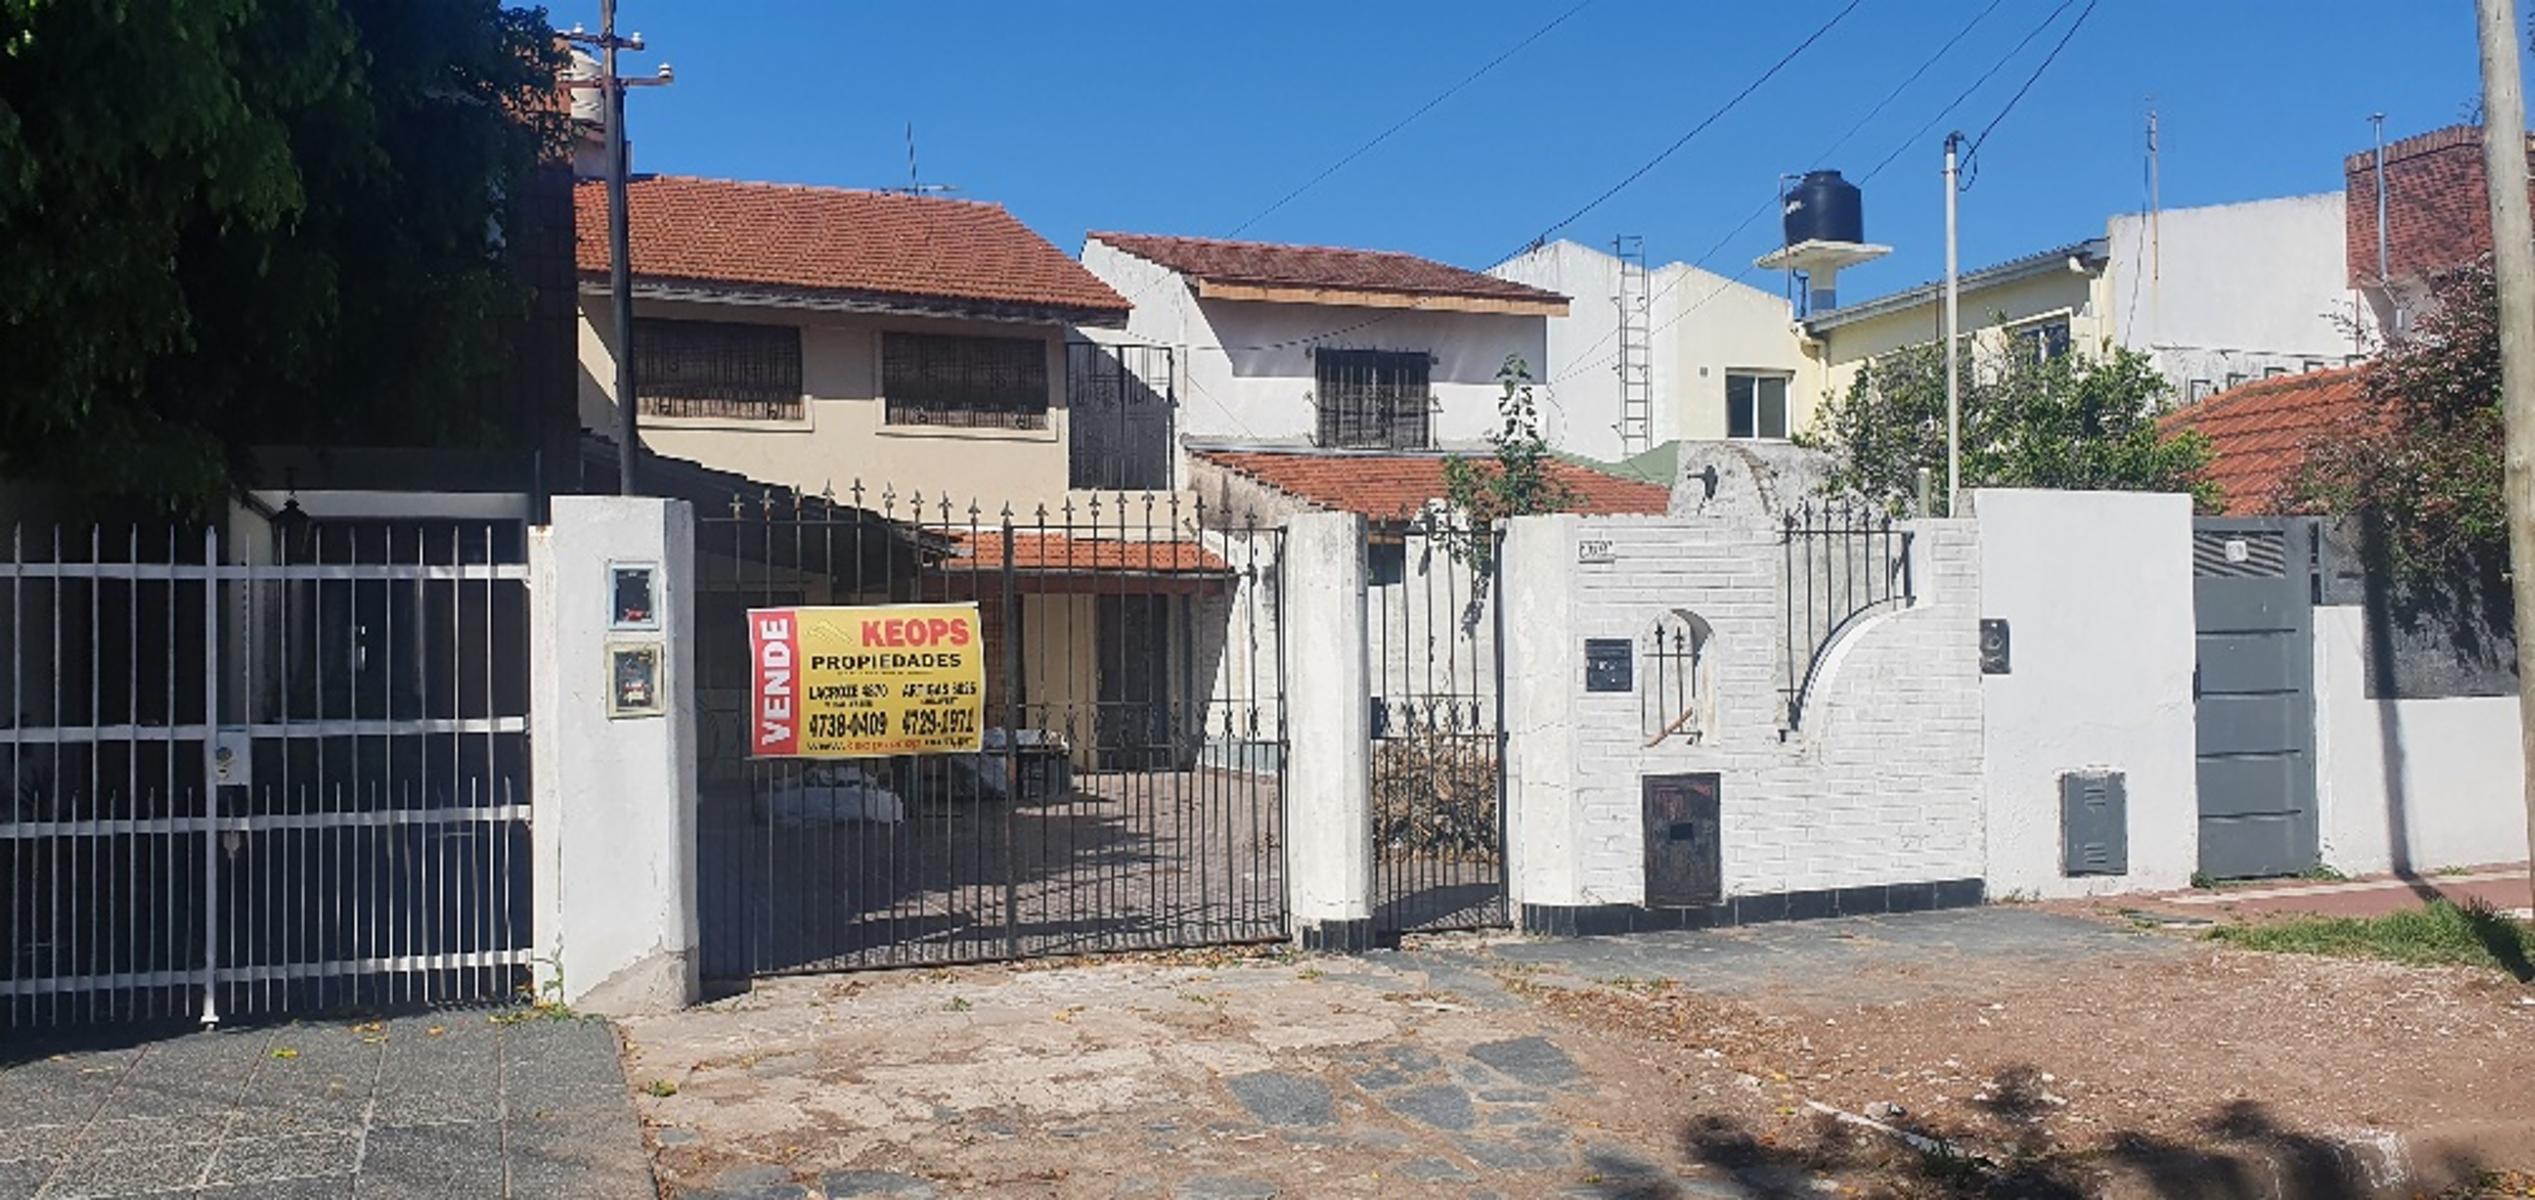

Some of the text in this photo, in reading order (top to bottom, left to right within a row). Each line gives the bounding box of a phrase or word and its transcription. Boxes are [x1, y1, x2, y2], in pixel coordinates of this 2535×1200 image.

[861, 618, 970, 648] KEOPS
[811, 653, 962, 670] PROPIEDADES
[760, 618, 792, 746] VENDE
[902, 682, 949, 698] ARTGAS
[809, 711, 888, 738] 4738-0409
[902, 707, 975, 736] 4729-1971
